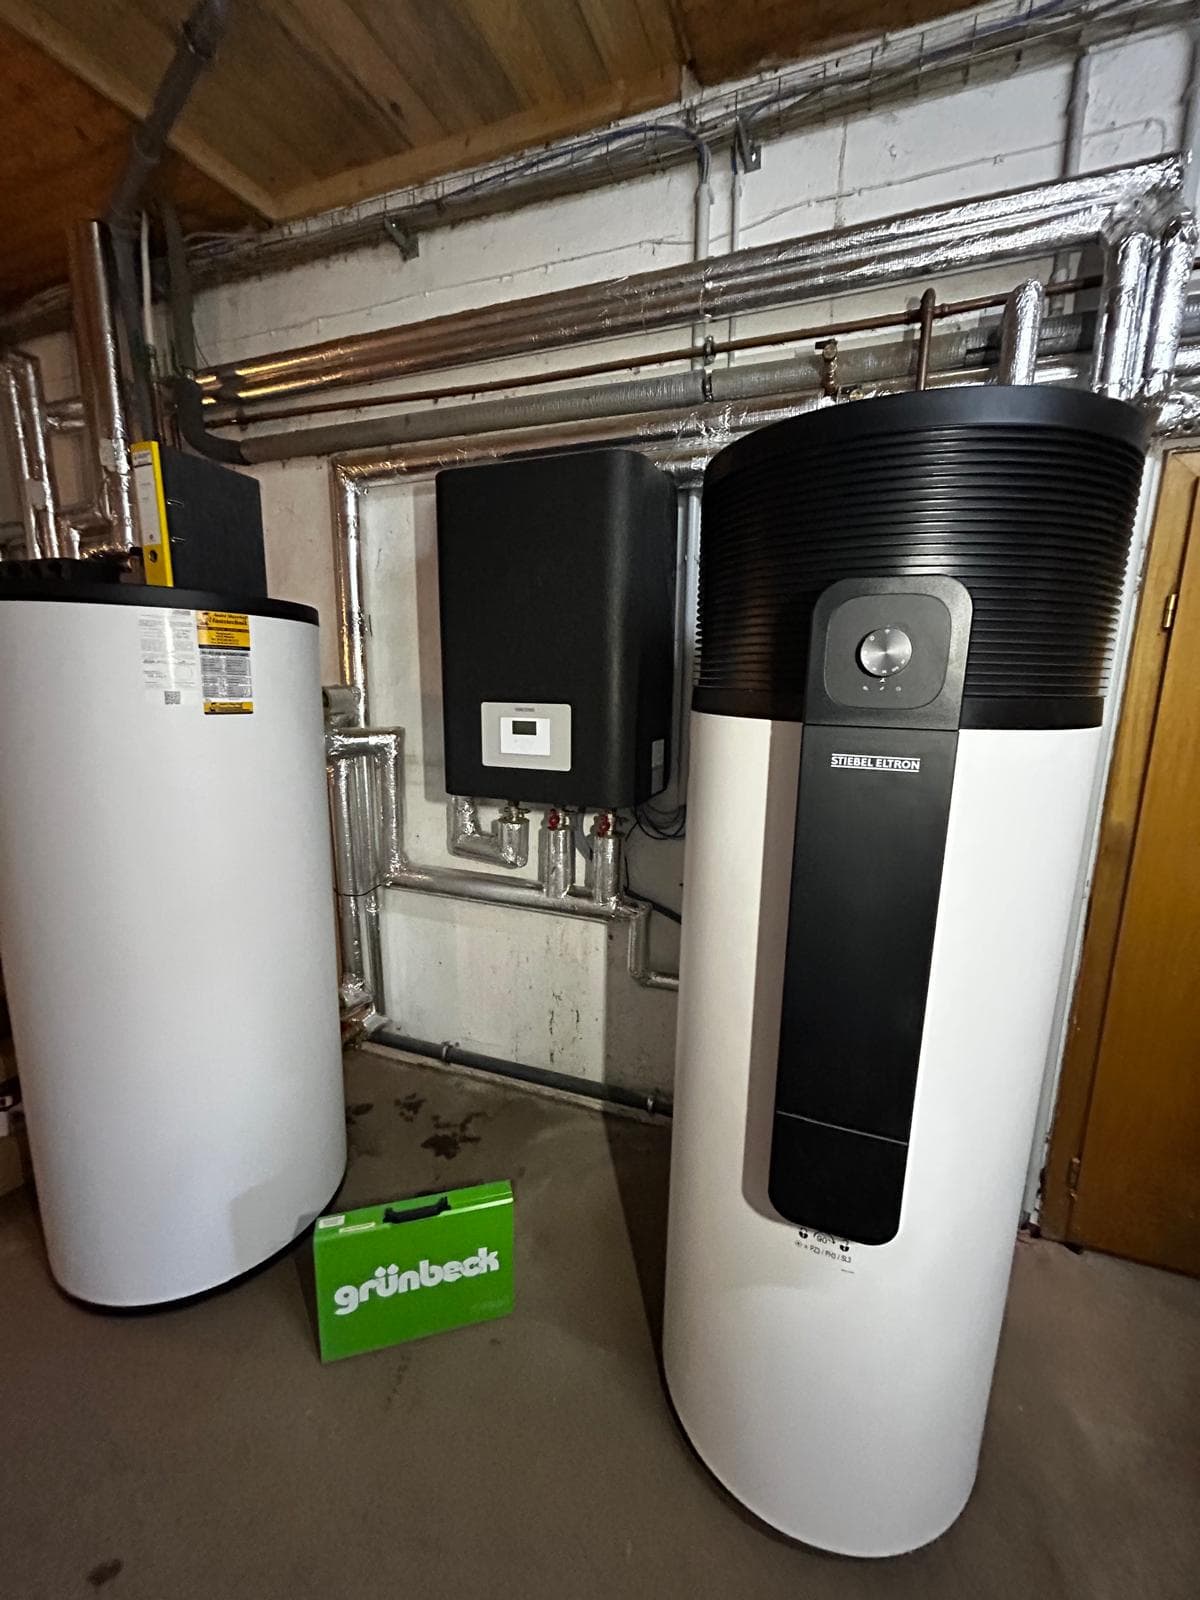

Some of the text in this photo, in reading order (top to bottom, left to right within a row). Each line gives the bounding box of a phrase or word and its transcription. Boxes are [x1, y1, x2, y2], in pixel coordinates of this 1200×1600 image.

[831, 756, 920, 770] STIEBEL ELTRON
[333, 1246, 500, 1316] grünbeck
